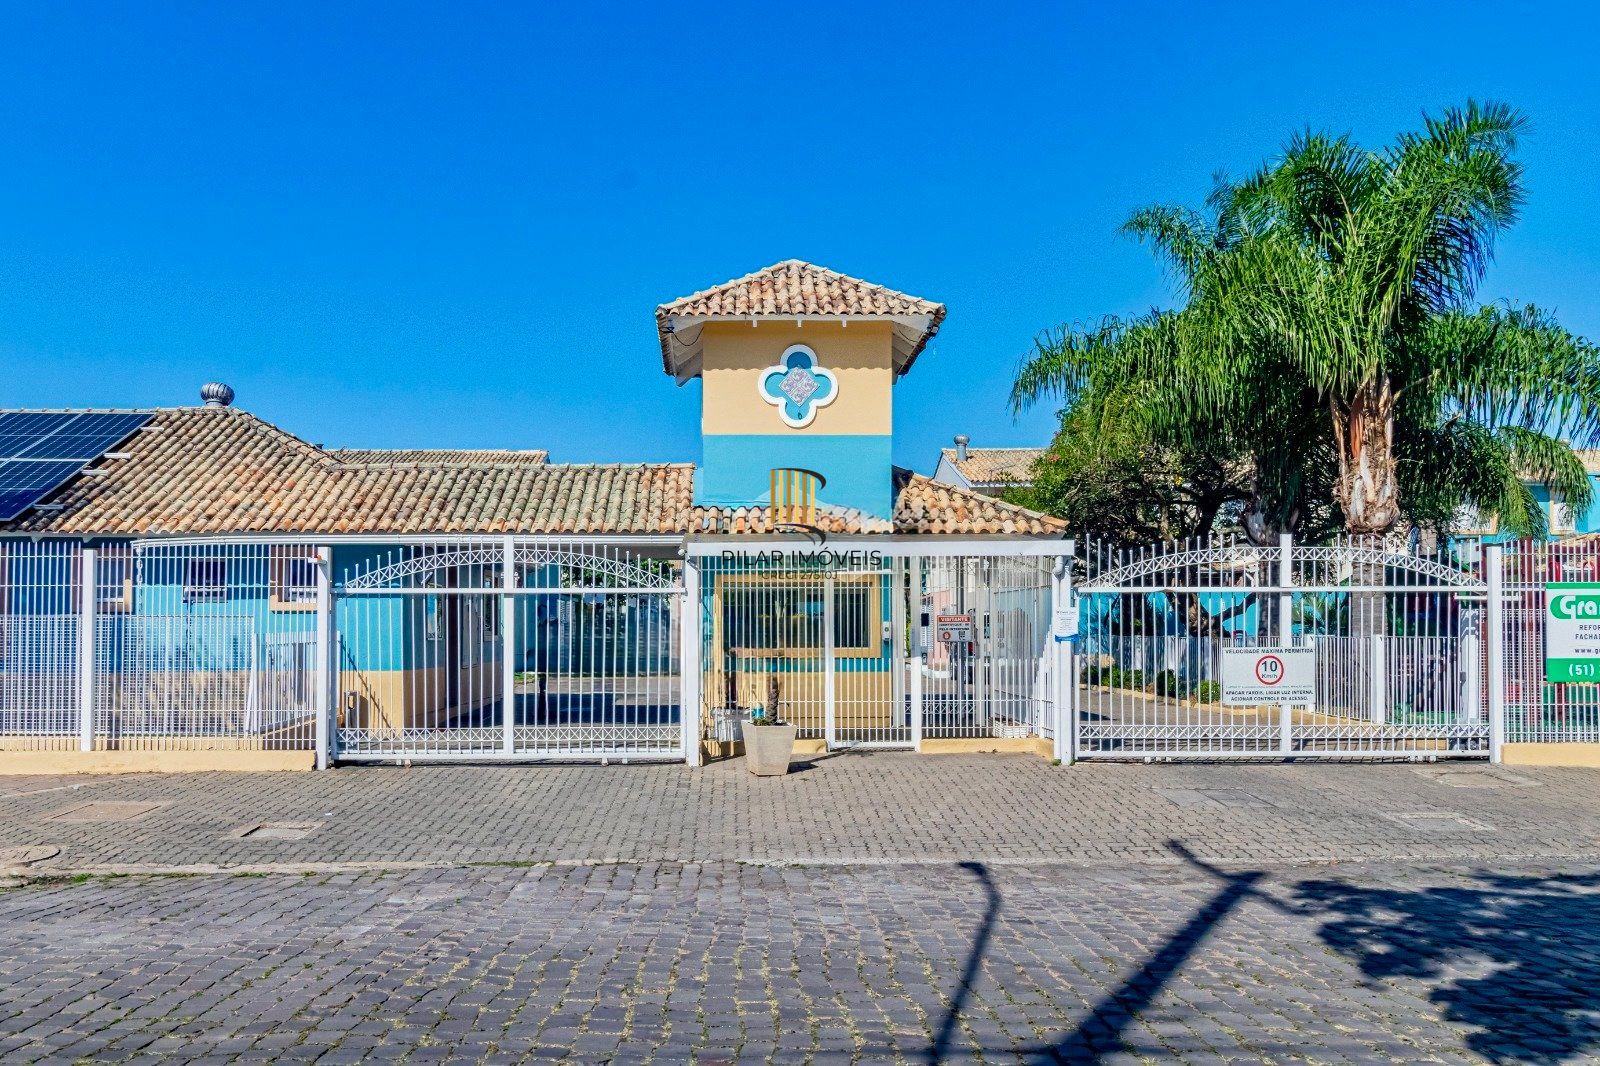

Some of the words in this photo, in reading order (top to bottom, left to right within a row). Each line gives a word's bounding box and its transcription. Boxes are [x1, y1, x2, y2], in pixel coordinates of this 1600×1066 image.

[1560, 595, 1600, 619] Gra
[1261, 660, 1278, 672] 10
[1569, 663, 1595, 677] (51)
